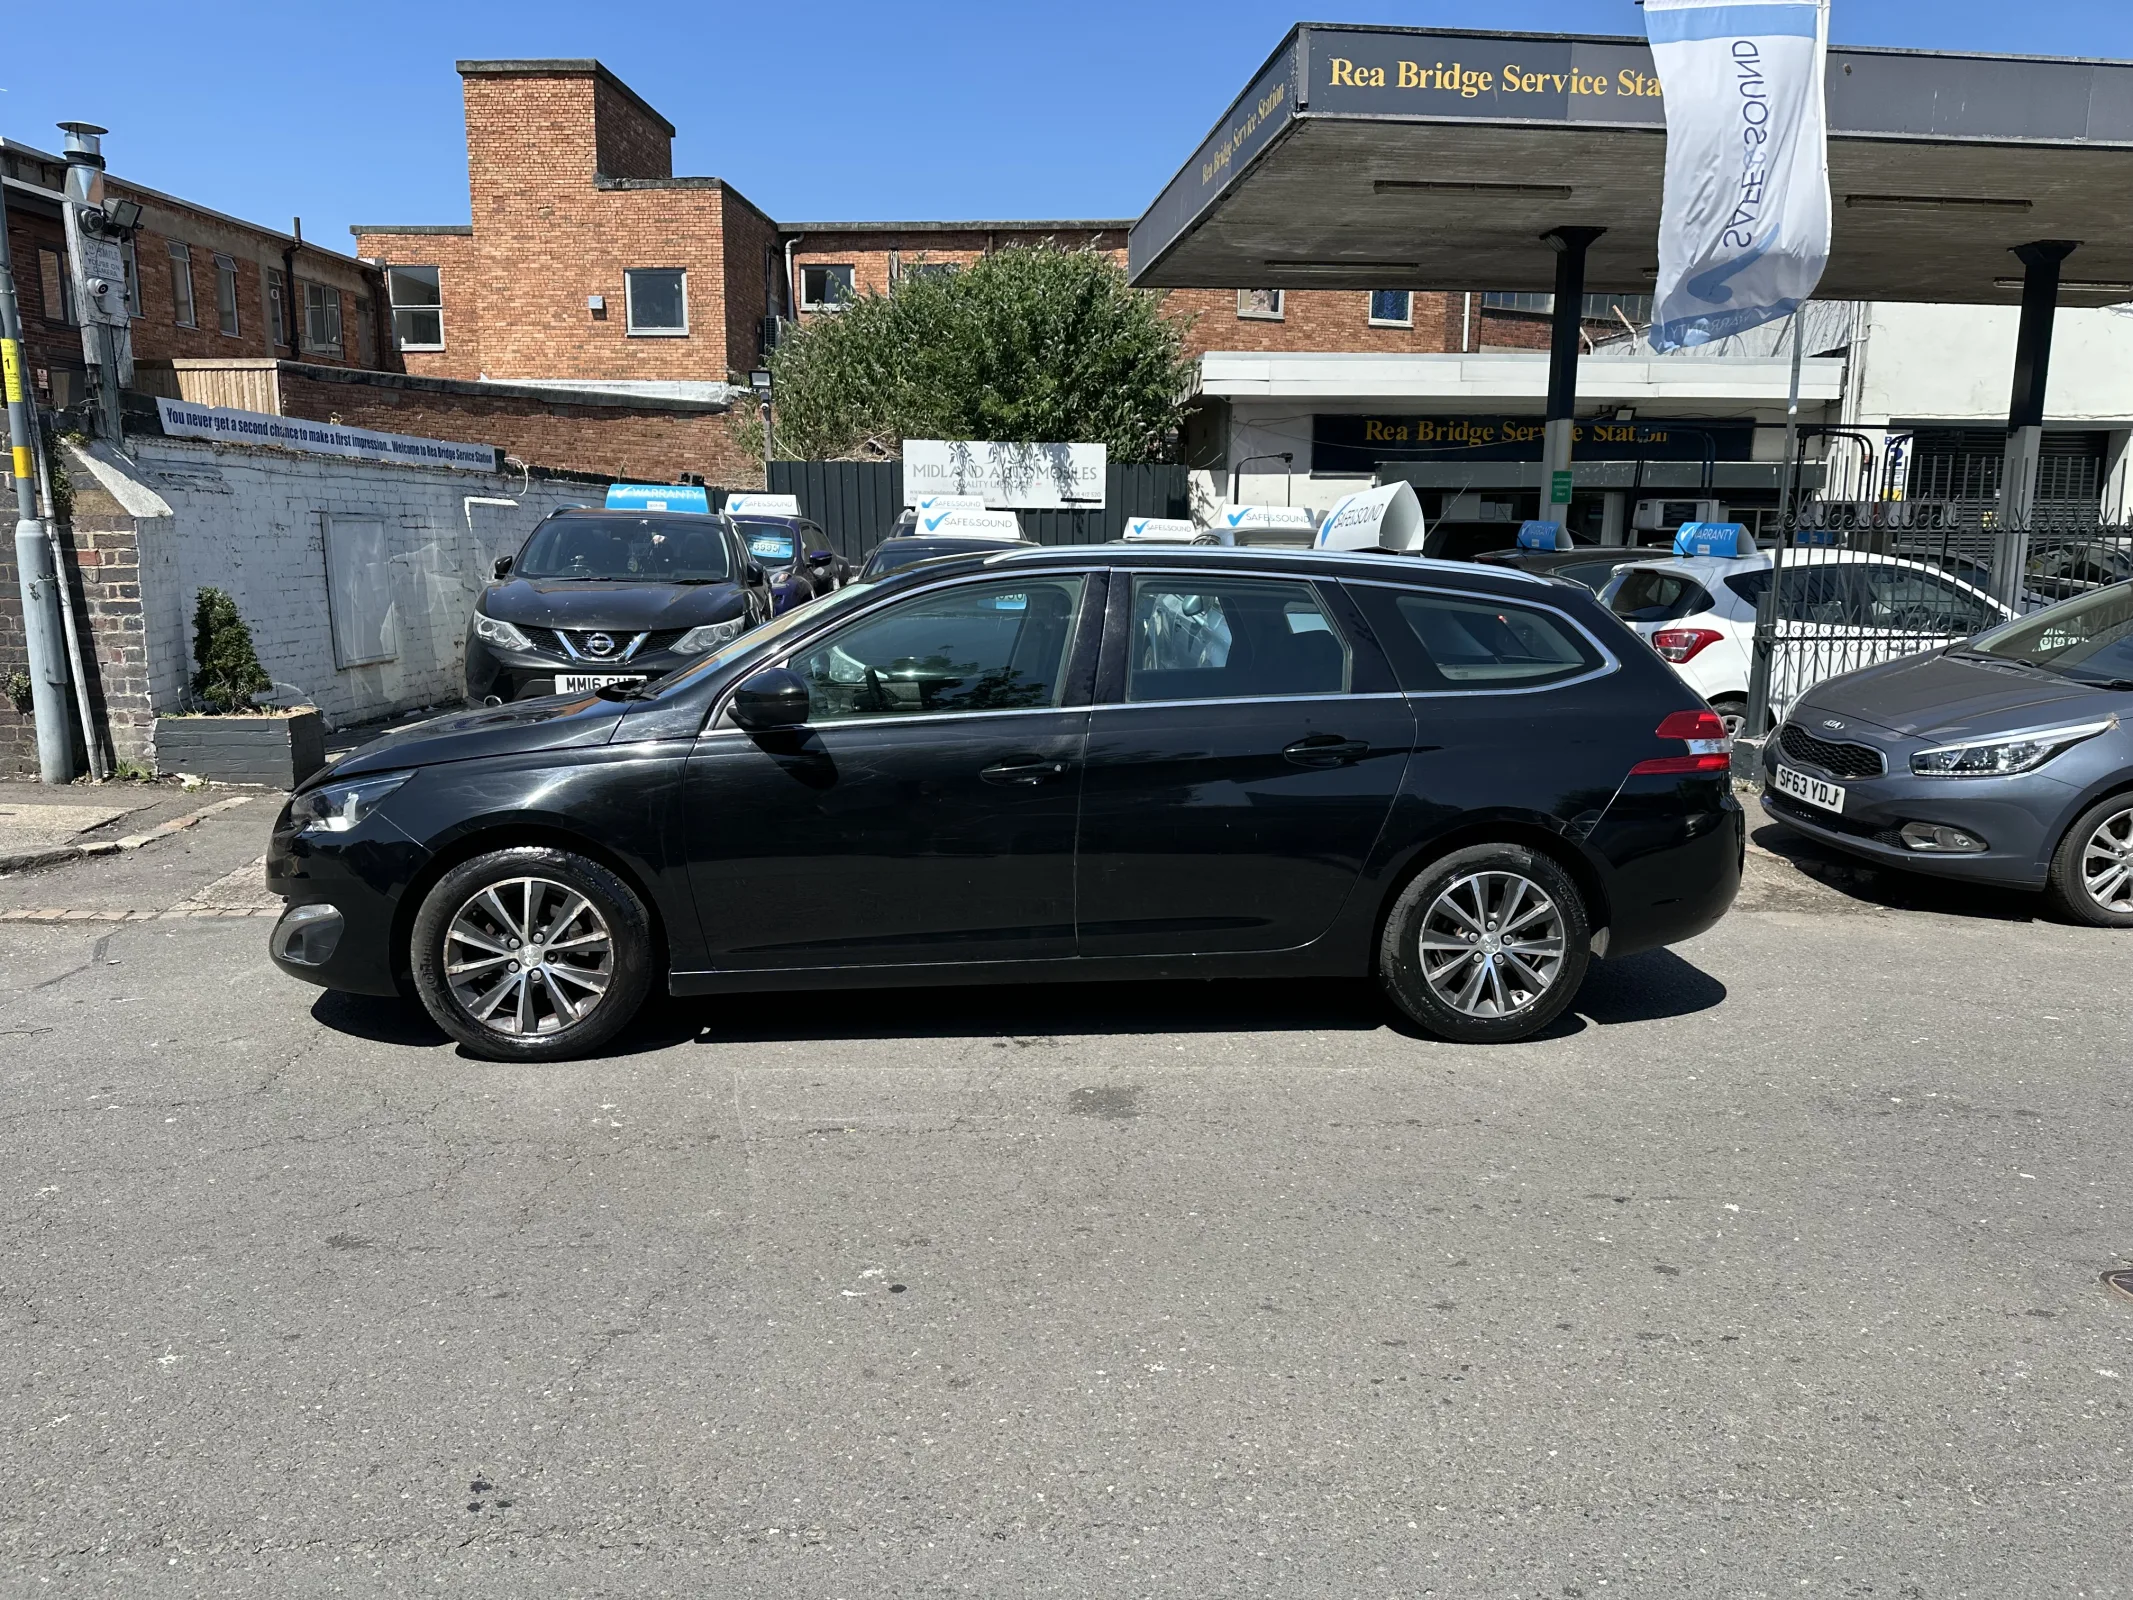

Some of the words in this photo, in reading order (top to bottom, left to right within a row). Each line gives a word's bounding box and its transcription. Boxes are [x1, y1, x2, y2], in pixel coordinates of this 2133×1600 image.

[1329, 58, 1385, 87] Rea
[1396, 60, 1493, 98] Bridge
[1502, 64, 1608, 95] Service
[1202, 162, 1213, 186] Rea
[1213, 140, 1233, 174] Bridge
[1233, 113, 1257, 152] Service
[1258, 83, 1285, 124] Station
[166, 407, 185, 424] You
[186, 412, 212, 428] never
[214, 416, 230, 432] get
[231, 419, 236, 430] a
[238, 419, 268, 435] second
[269, 423, 299, 440] chance
[299, 428, 308, 441] to
[309, 429, 329, 444] make
[330, 434, 335, 443] a
[335, 432, 352, 447] first
[392, 441, 420, 455] Welcome
[420, 444, 427, 455] to
[427, 446, 438, 457] Rea
[438, 446, 456, 460] Bridge
[456, 449, 475, 462] Service
[475, 451, 493, 464] Station
[1365, 420, 1408, 441] Rea
[1416, 420, 1494, 447] Bridge
[913, 464, 984, 478] MIDLAND
[632, 487, 700, 499] WARRANTY
[944, 517, 1013, 528] SAFE&SOUND
[1245, 512, 1311, 524] SAFE&SOUND
[1146, 523, 1192, 533] SAFE&SOUND
[1692, 528, 1736, 541] WARRANTY
[566, 677, 601, 692] MM16
[1825, 720, 1841, 728] KIA
[1779, 768, 1808, 796] SF63
[1811, 780, 1840, 806] YDJ
